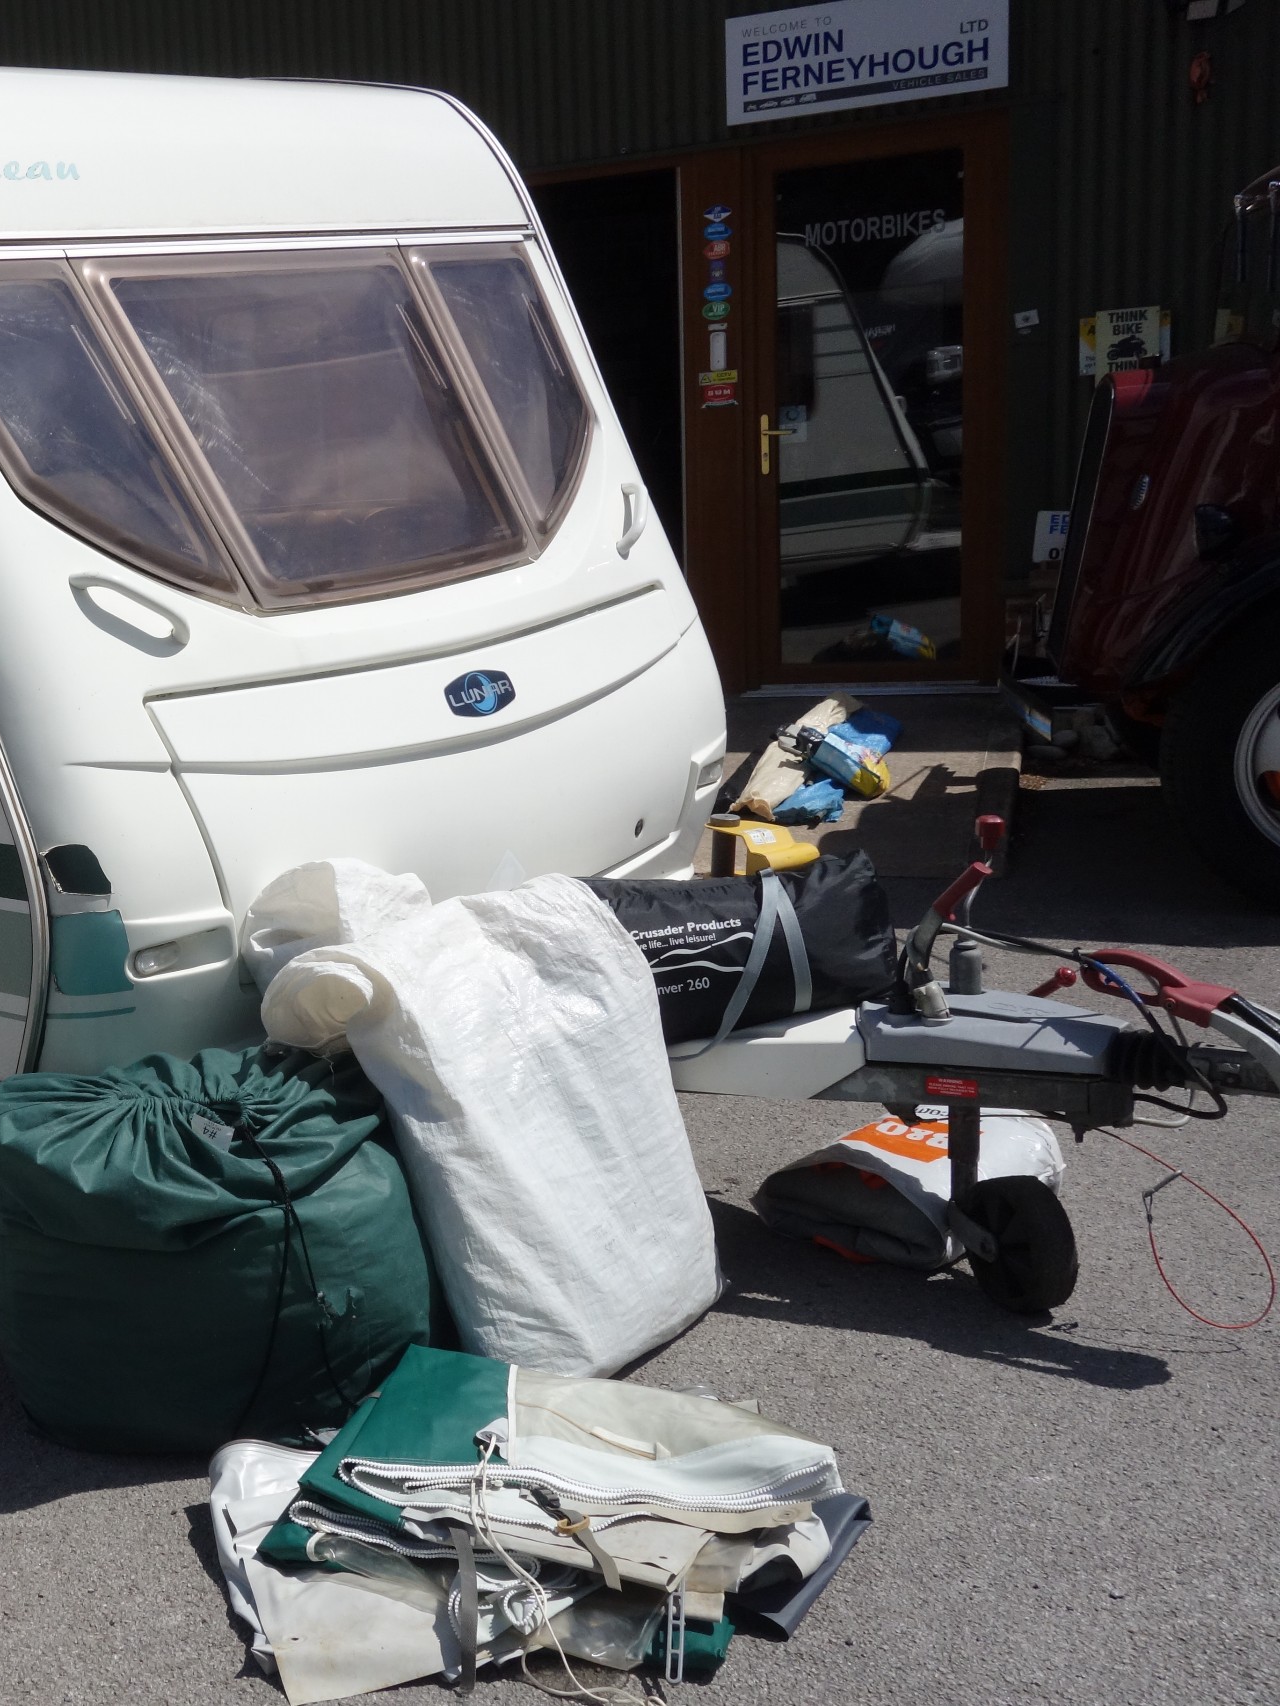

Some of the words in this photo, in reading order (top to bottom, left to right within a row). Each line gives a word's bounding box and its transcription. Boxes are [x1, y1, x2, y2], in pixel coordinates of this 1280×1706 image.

[741, 19, 808, 38] WELCOME
[815, 16, 833, 27] TO
[959, 18, 989, 35] LTD
[742, 29, 844, 67] EDWIN
[742, 37, 989, 96] FERNEYHOUGH
[892, 76, 942, 91] VEHICLE
[945, 69, 986, 84] SALES
[805, 208, 946, 247] MOTORBIKES
[1108, 309, 1148, 323] THINK
[1112, 322, 1144, 335] BIKE
[1107, 359, 1138, 372] THIN
[449, 680, 512, 707] LUNAR
[630, 926, 684, 941] Crusader
[687, 918, 742, 932] Products
[669, 935, 684, 945] live
[686, 933, 717, 944] leisure!
[656, 984, 684, 995] nver
[686, 976, 710, 991] 260
